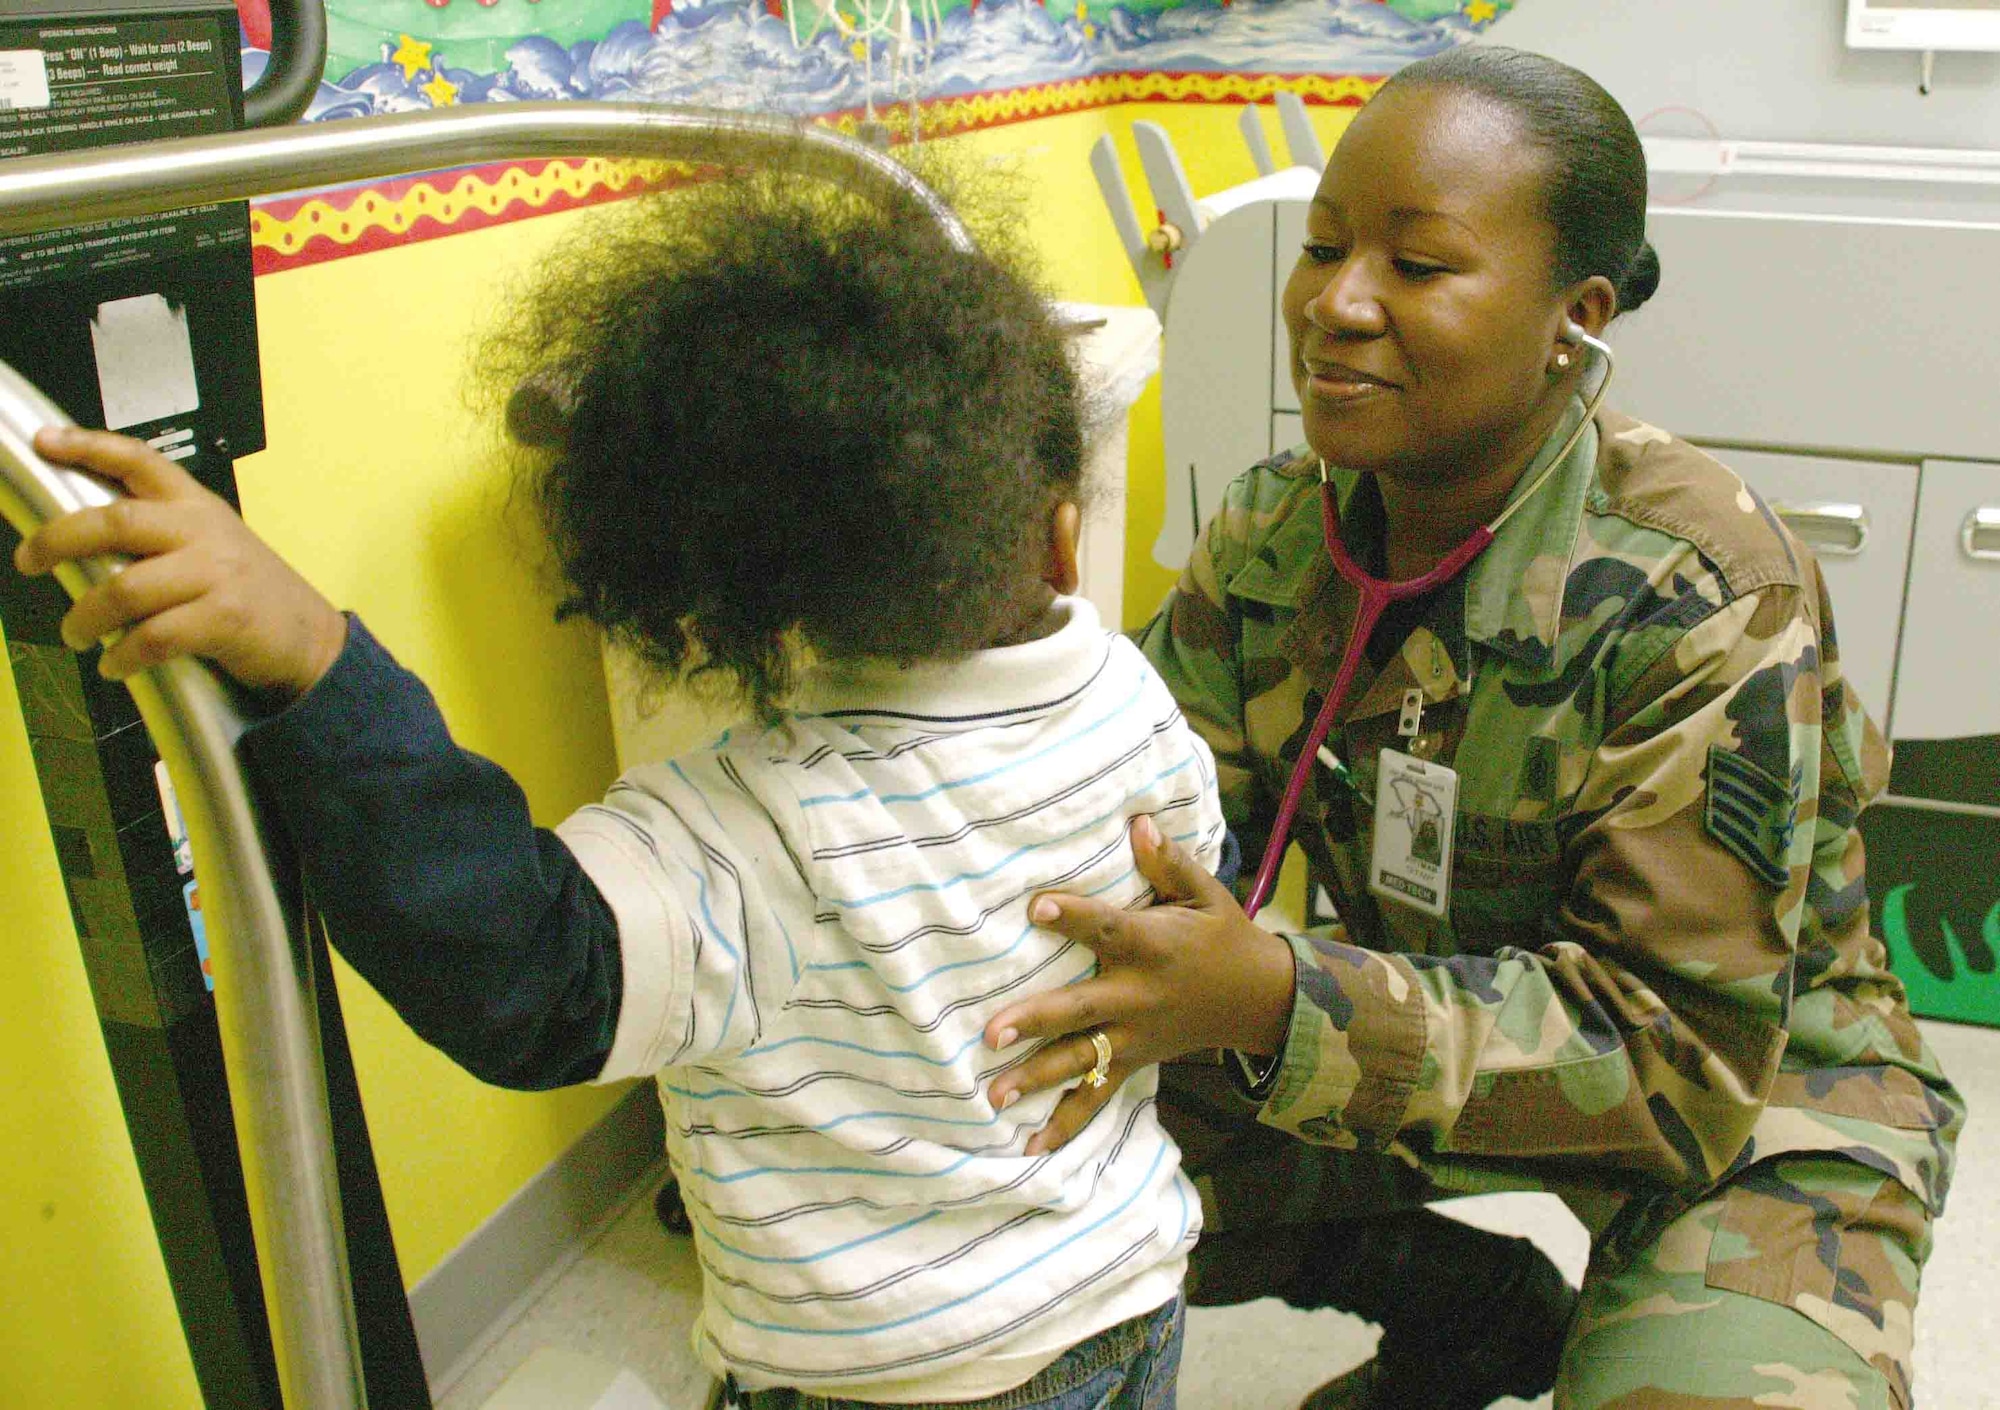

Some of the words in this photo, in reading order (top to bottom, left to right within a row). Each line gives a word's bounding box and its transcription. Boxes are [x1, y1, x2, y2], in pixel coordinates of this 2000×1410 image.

[98, 44, 123, 60] Beep)
[128, 43, 148, 57] Wait
[148, 42, 159, 55] for
[160, 42, 176, 54] zero
[186, 38, 213, 53] Beeps)
[56, 65, 86, 80] Beeps)
[102, 62, 124, 76] Read
[124, 61, 151, 75] correct
[151, 58, 178, 73] weight
[23, 127, 45, 137] BLACK
[46, 124, 77, 134] STEERING
[79, 120, 103, 130] HANDLE
[104, 118, 123, 127] WHILE
[124, 117, 134, 125] ON
[135, 115, 154, 123] SCALE
[21, 251, 35, 261] NOT
[36, 249, 46, 258] TO
[46, 247, 56, 256] BE
[56, 244, 74, 254] USED
[75, 242, 84, 250] TO
[84, 236, 120, 248] TRANSPORT
[121, 230, 149, 241] PATIENTS
[150, 229, 159, 237] OR
[31, 231, 61, 243] LOCATED
